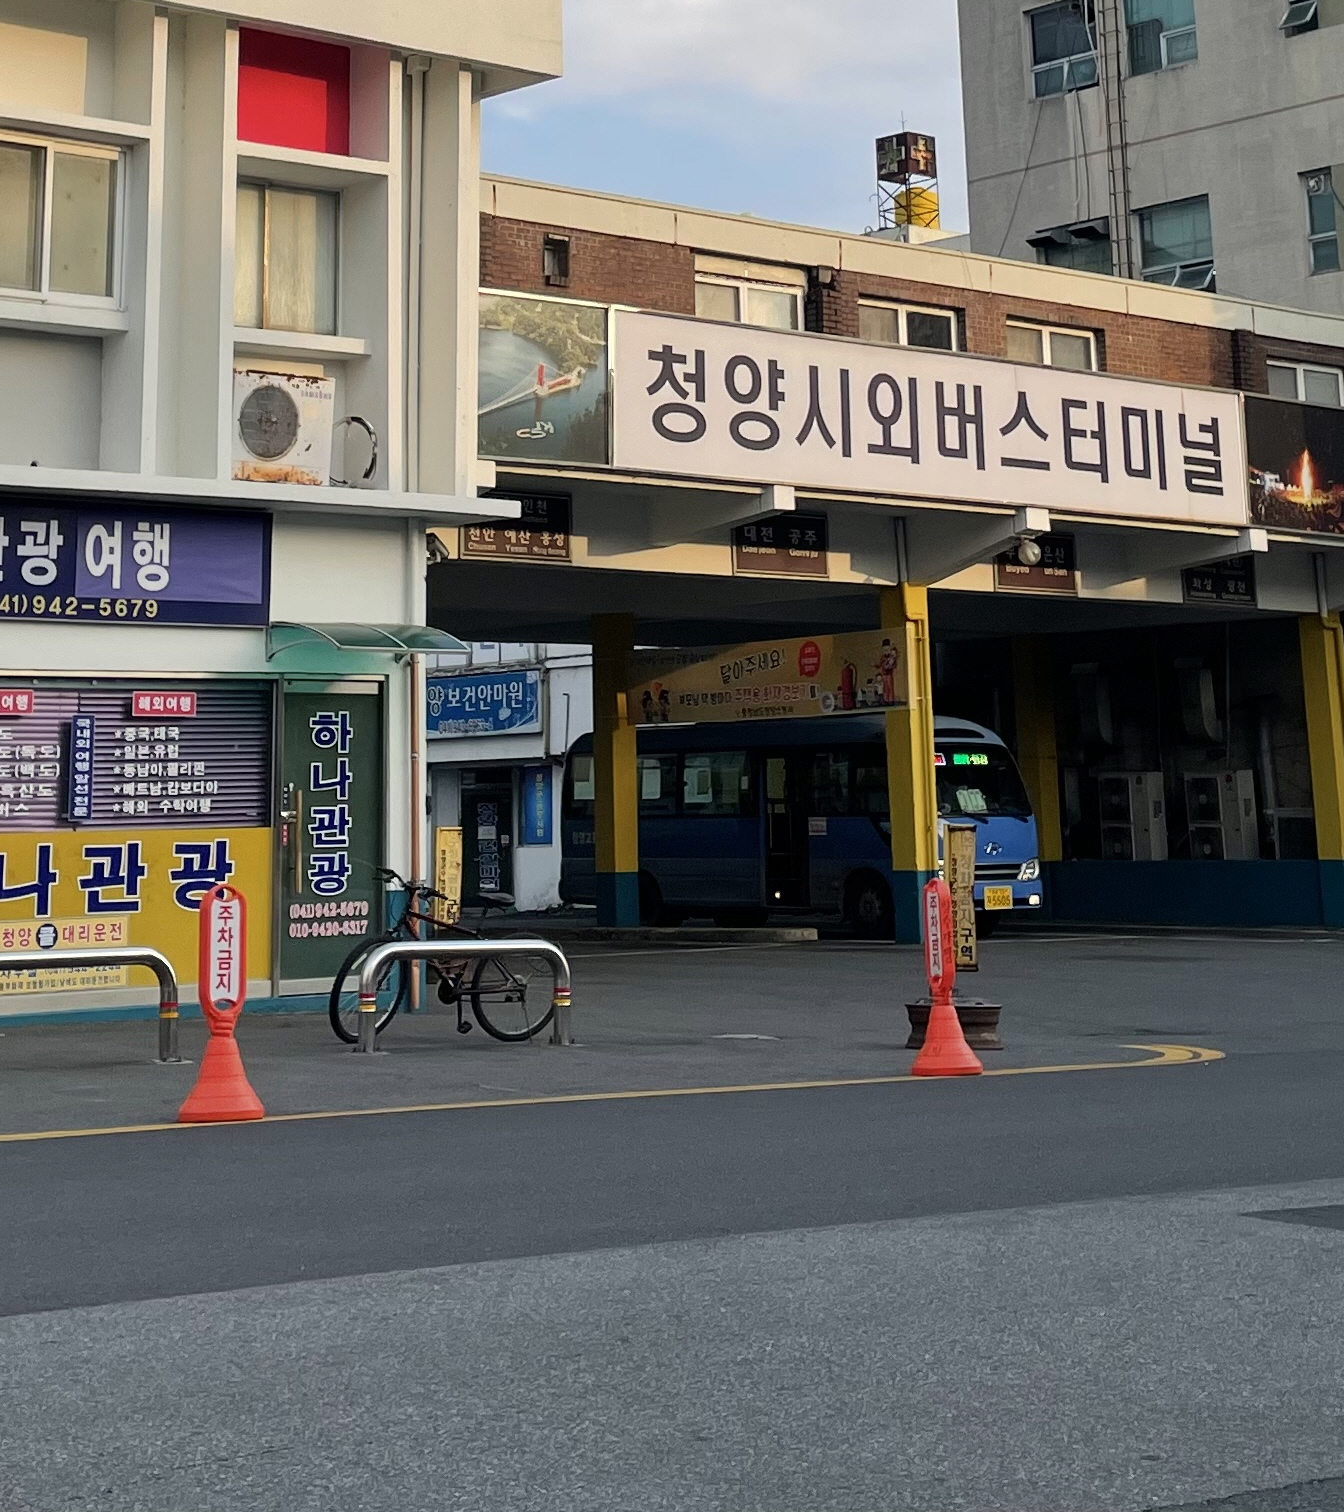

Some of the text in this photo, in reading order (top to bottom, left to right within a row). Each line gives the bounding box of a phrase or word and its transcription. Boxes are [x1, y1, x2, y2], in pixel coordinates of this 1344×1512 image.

[646, 344, 1224, 497] 청양시외버스터미널
[743, 526, 819, 546] 대전 공주
[84, 520, 172, 592] 여행
[138, 695, 192, 712] 해외여행
[446, 682, 523, 712] 보건안마원
[122, 799, 149, 816] 해외
[308, 711, 354, 897] 하나관광
[289, 900, 370, 920] (041)942-5679
[2, 927, 31, 951] 청양
[62, 922, 123, 945] 대리운전
[216, 906, 235, 994] 주차금지
